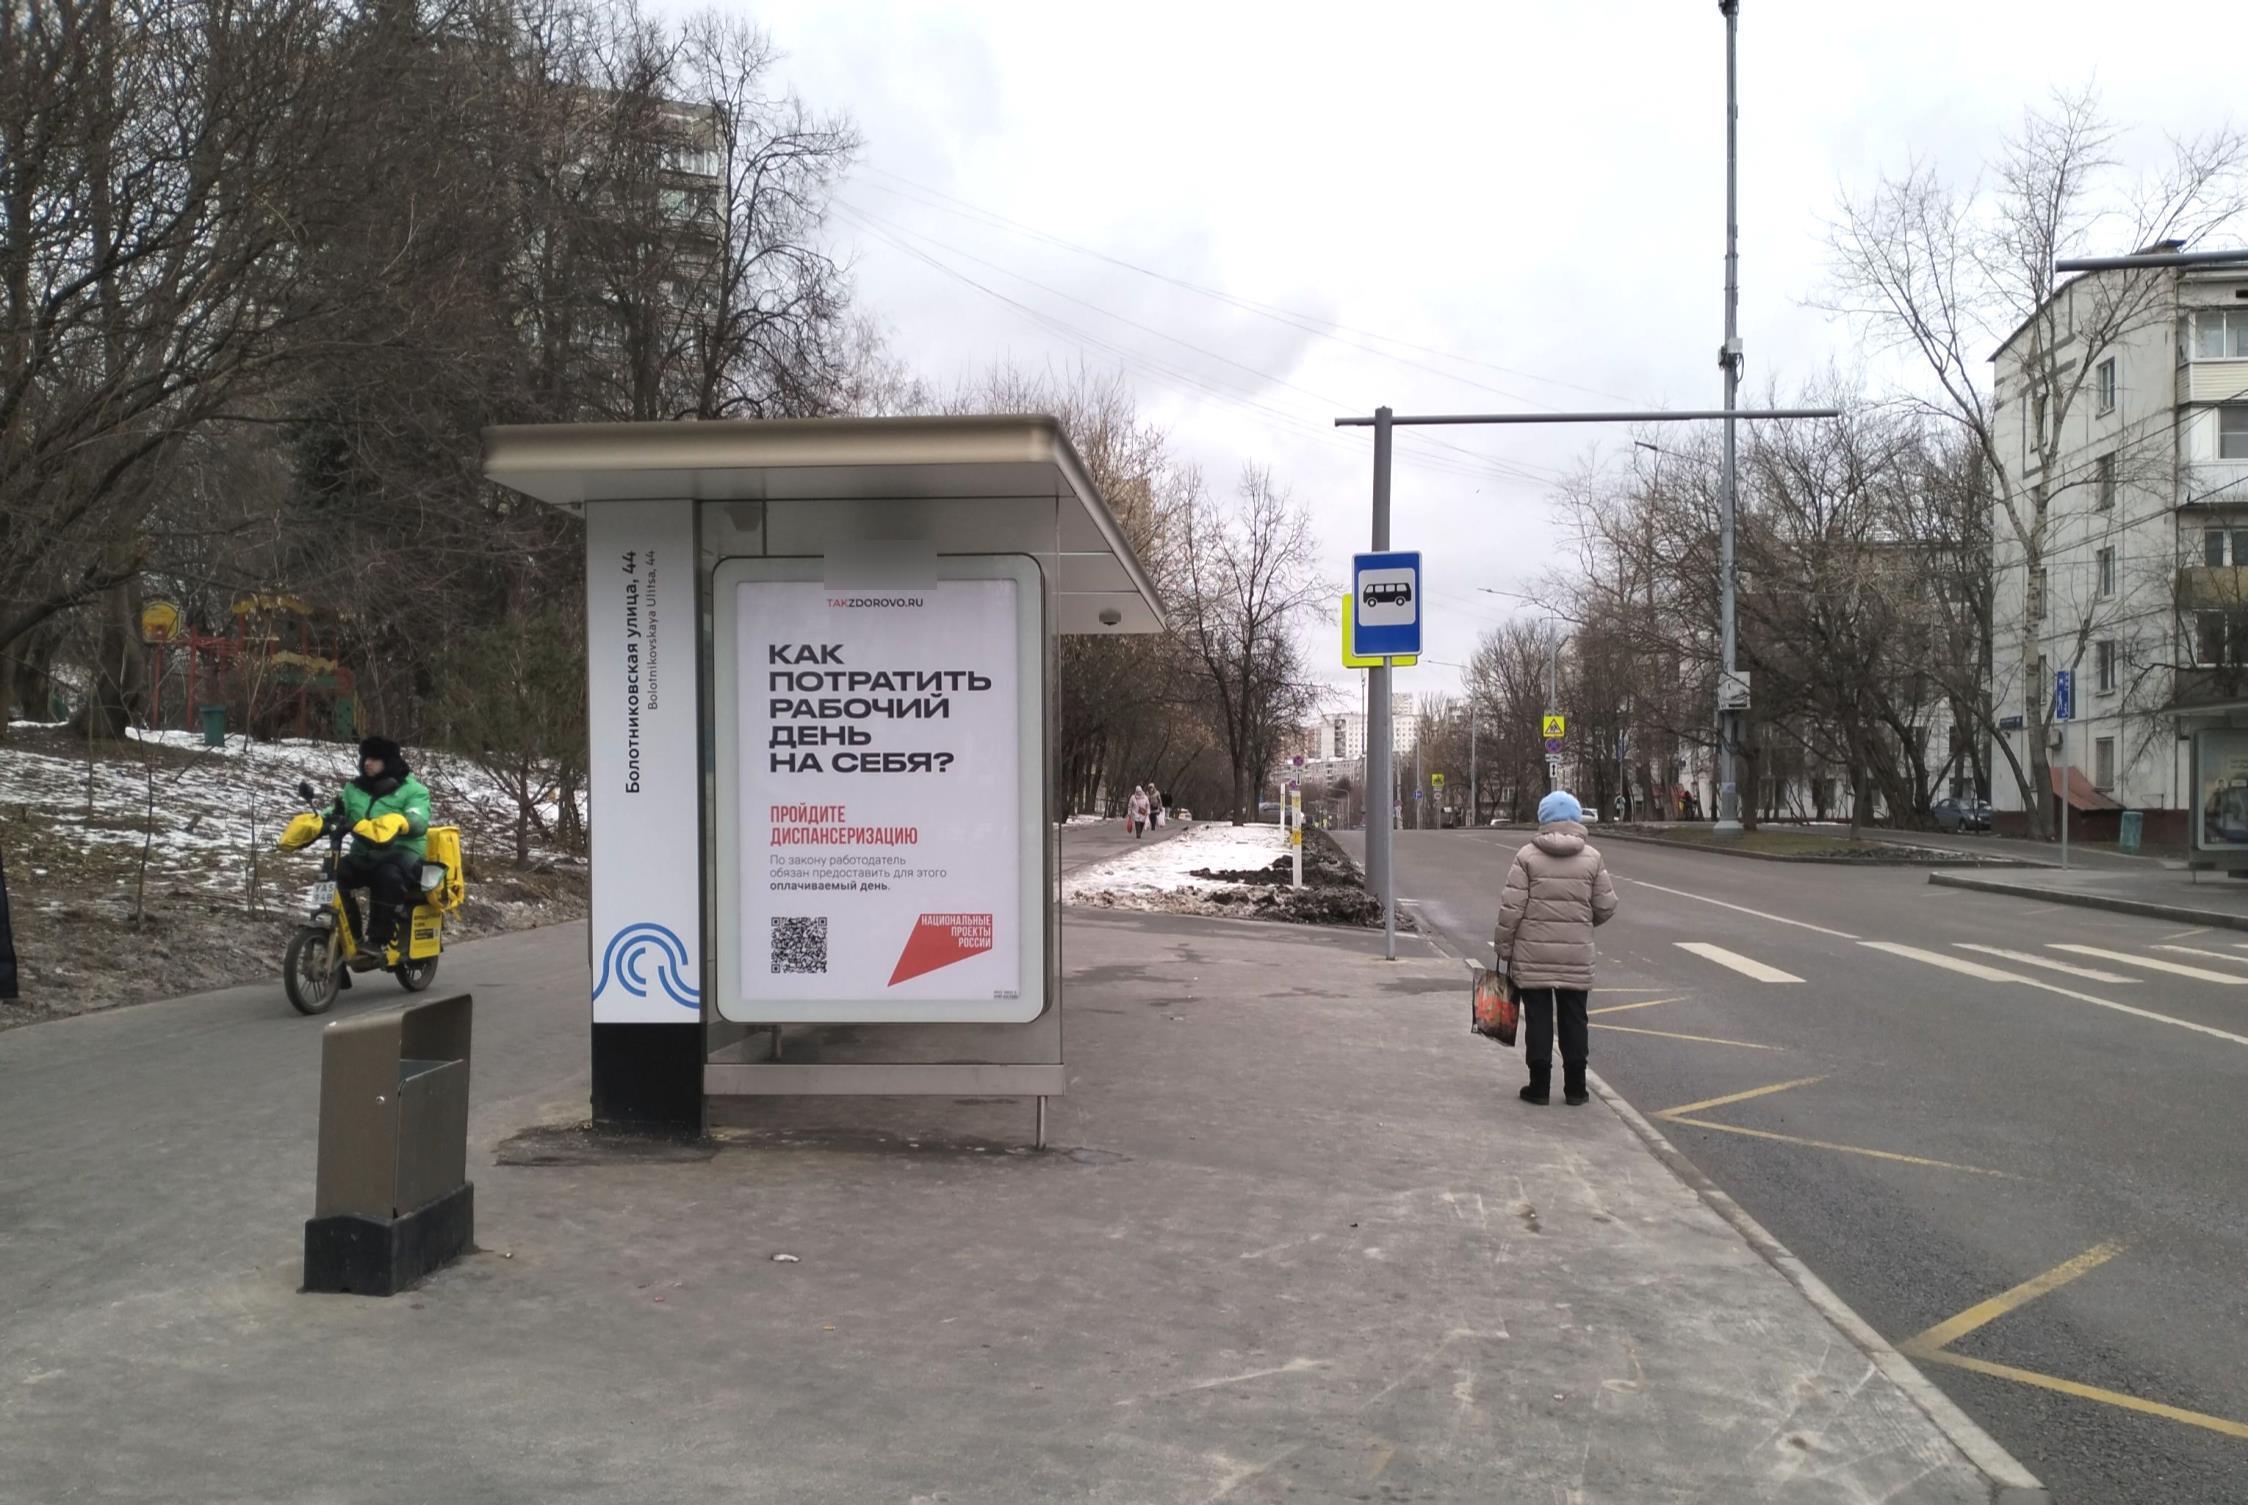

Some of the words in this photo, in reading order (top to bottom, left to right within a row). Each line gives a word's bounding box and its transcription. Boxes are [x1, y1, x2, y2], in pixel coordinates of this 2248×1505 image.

[622, 550, 636, 574] 44
[645, 550, 655, 566] 44
[646, 569, 656, 607] Ulitsa,
[626, 579, 641, 638] улица,
[827, 598, 923, 608] TAKZDOROVO.RU
[647, 610, 658, 710] Bolotnikovskaya
[769, 644, 844, 664] КАК
[769, 671, 992, 691] ПОТРАТИТЬ
[769, 693, 949, 719] РАБОЧИЙ
[626, 642, 640, 793] Болотниковская
[769, 726, 872, 749] ДЕНЬ
[770, 752, 824, 773] НА
[832, 752, 954, 773] СЕБЯ?
[770, 802, 845, 824] ПРОЙДИТЕ
[770, 827, 918, 847] ДИСПАНСЕРИЗАЦИЮ
[770, 854, 785, 865] По
[788, 856, 826, 867] закону
[829, 854, 906, 867] работодатель
[770, 868, 809, 878] обязан
[812, 869, 890, 879] предоставить
[893, 869, 914, 879] для
[916, 869, 947, 878] этого
[770, 881, 857, 891] оплачиваемый
[860, 882, 890, 892] день.
[921, 915, 991, 926] НАЦИОНАЛЬНЫЕ
[951, 926, 991, 937] ПРОЕКТЫ
[958, 937, 991, 948] РОССИИ
